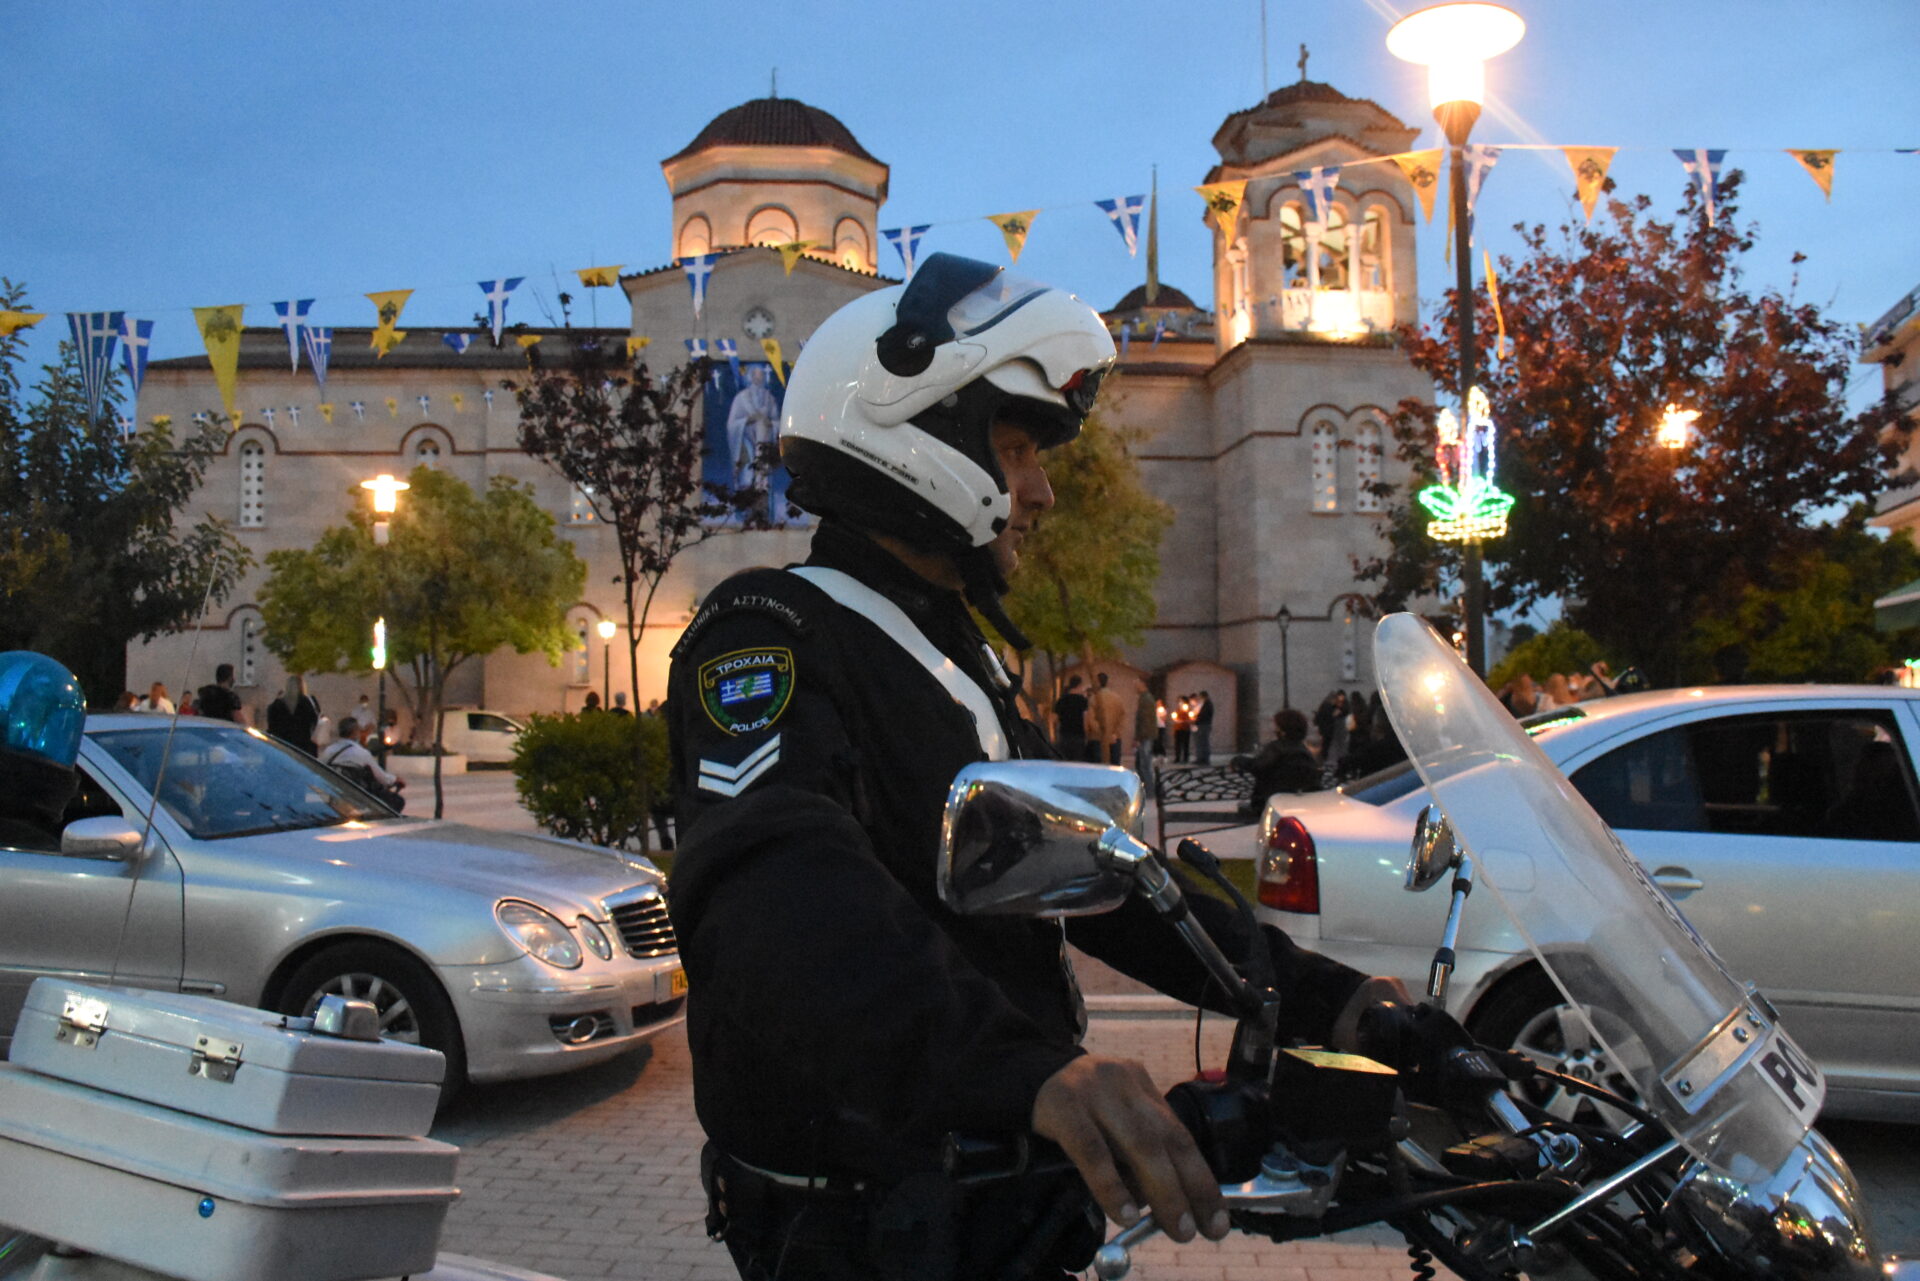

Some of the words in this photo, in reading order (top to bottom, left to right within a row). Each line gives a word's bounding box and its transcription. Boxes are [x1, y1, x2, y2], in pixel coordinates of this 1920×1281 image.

[841, 439, 888, 467] COMPOSITE
[733, 595, 803, 627] ΑΣΤΥΝΟΜΙΑ
[716, 654, 775, 675] ΤΡΟΧΑΙΑ
[730, 716, 770, 732] POLICE
[1760, 1035, 1818, 1112] PO
